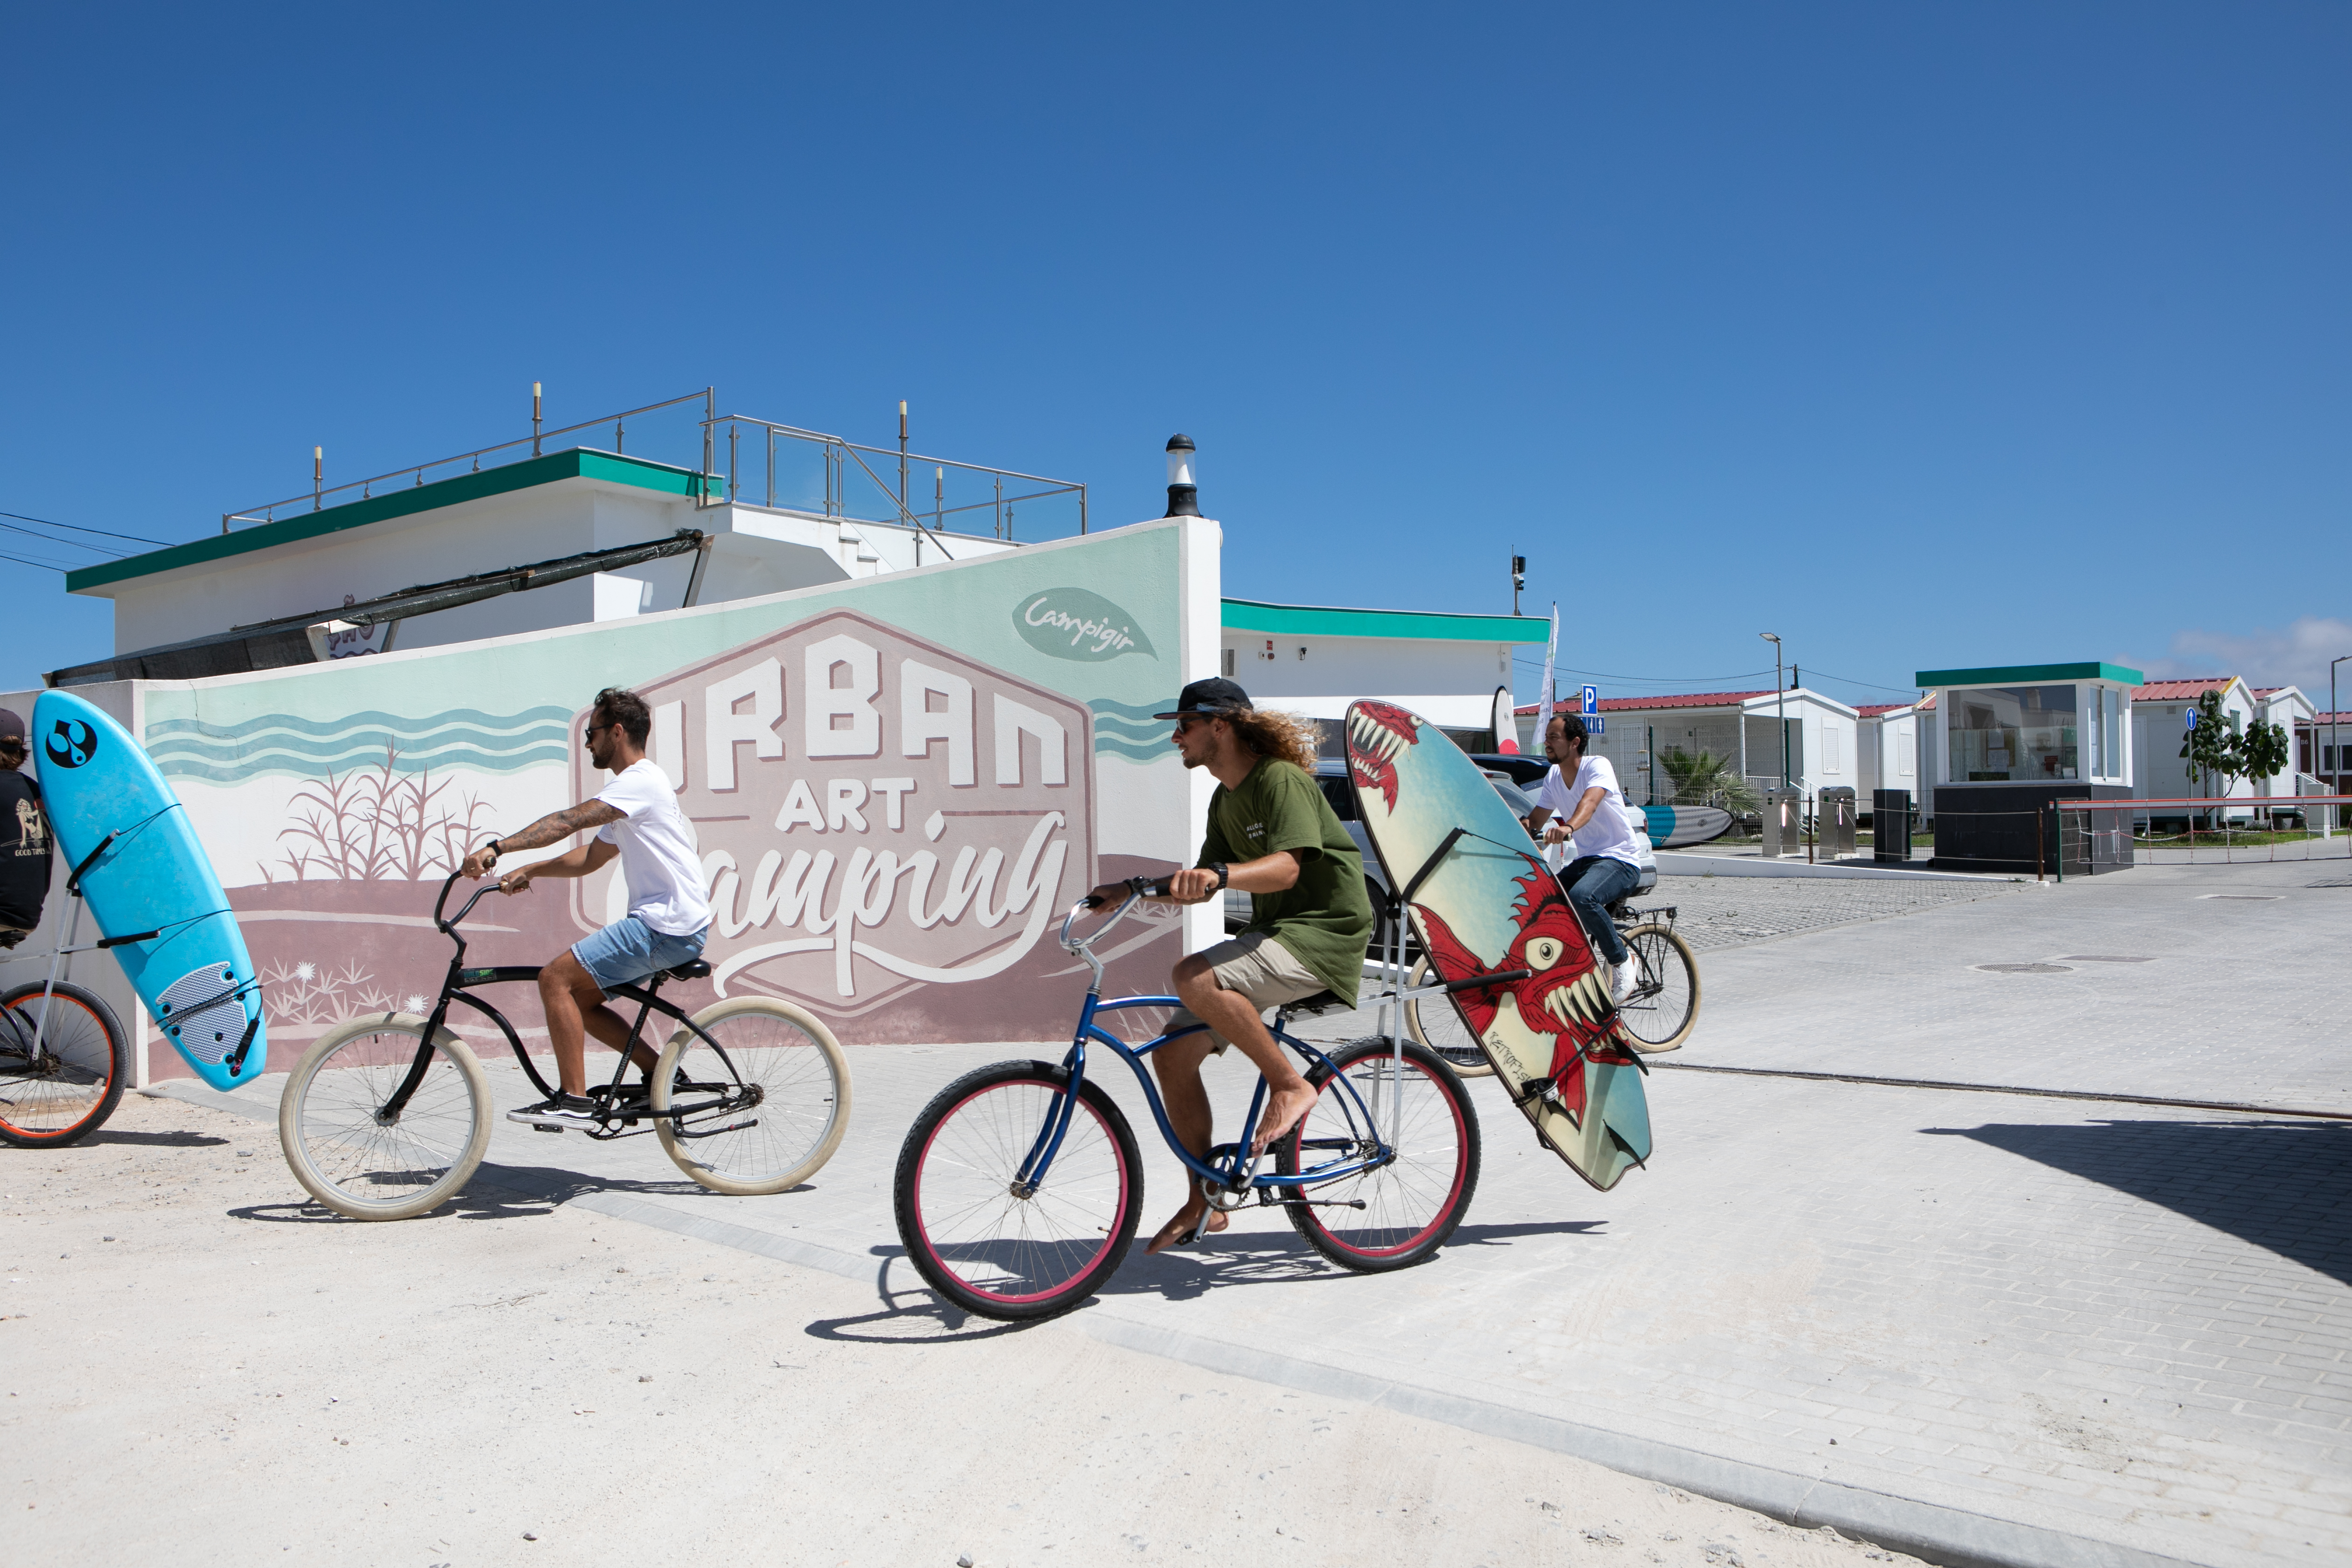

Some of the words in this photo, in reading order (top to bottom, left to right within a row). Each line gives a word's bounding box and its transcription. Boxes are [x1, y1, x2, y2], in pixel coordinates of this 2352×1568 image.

[1025, 597, 1134, 652] Campigir
[1585, 688, 1594, 712] P
[775, 778, 915, 833] ART
[606, 810, 1070, 998] amping
